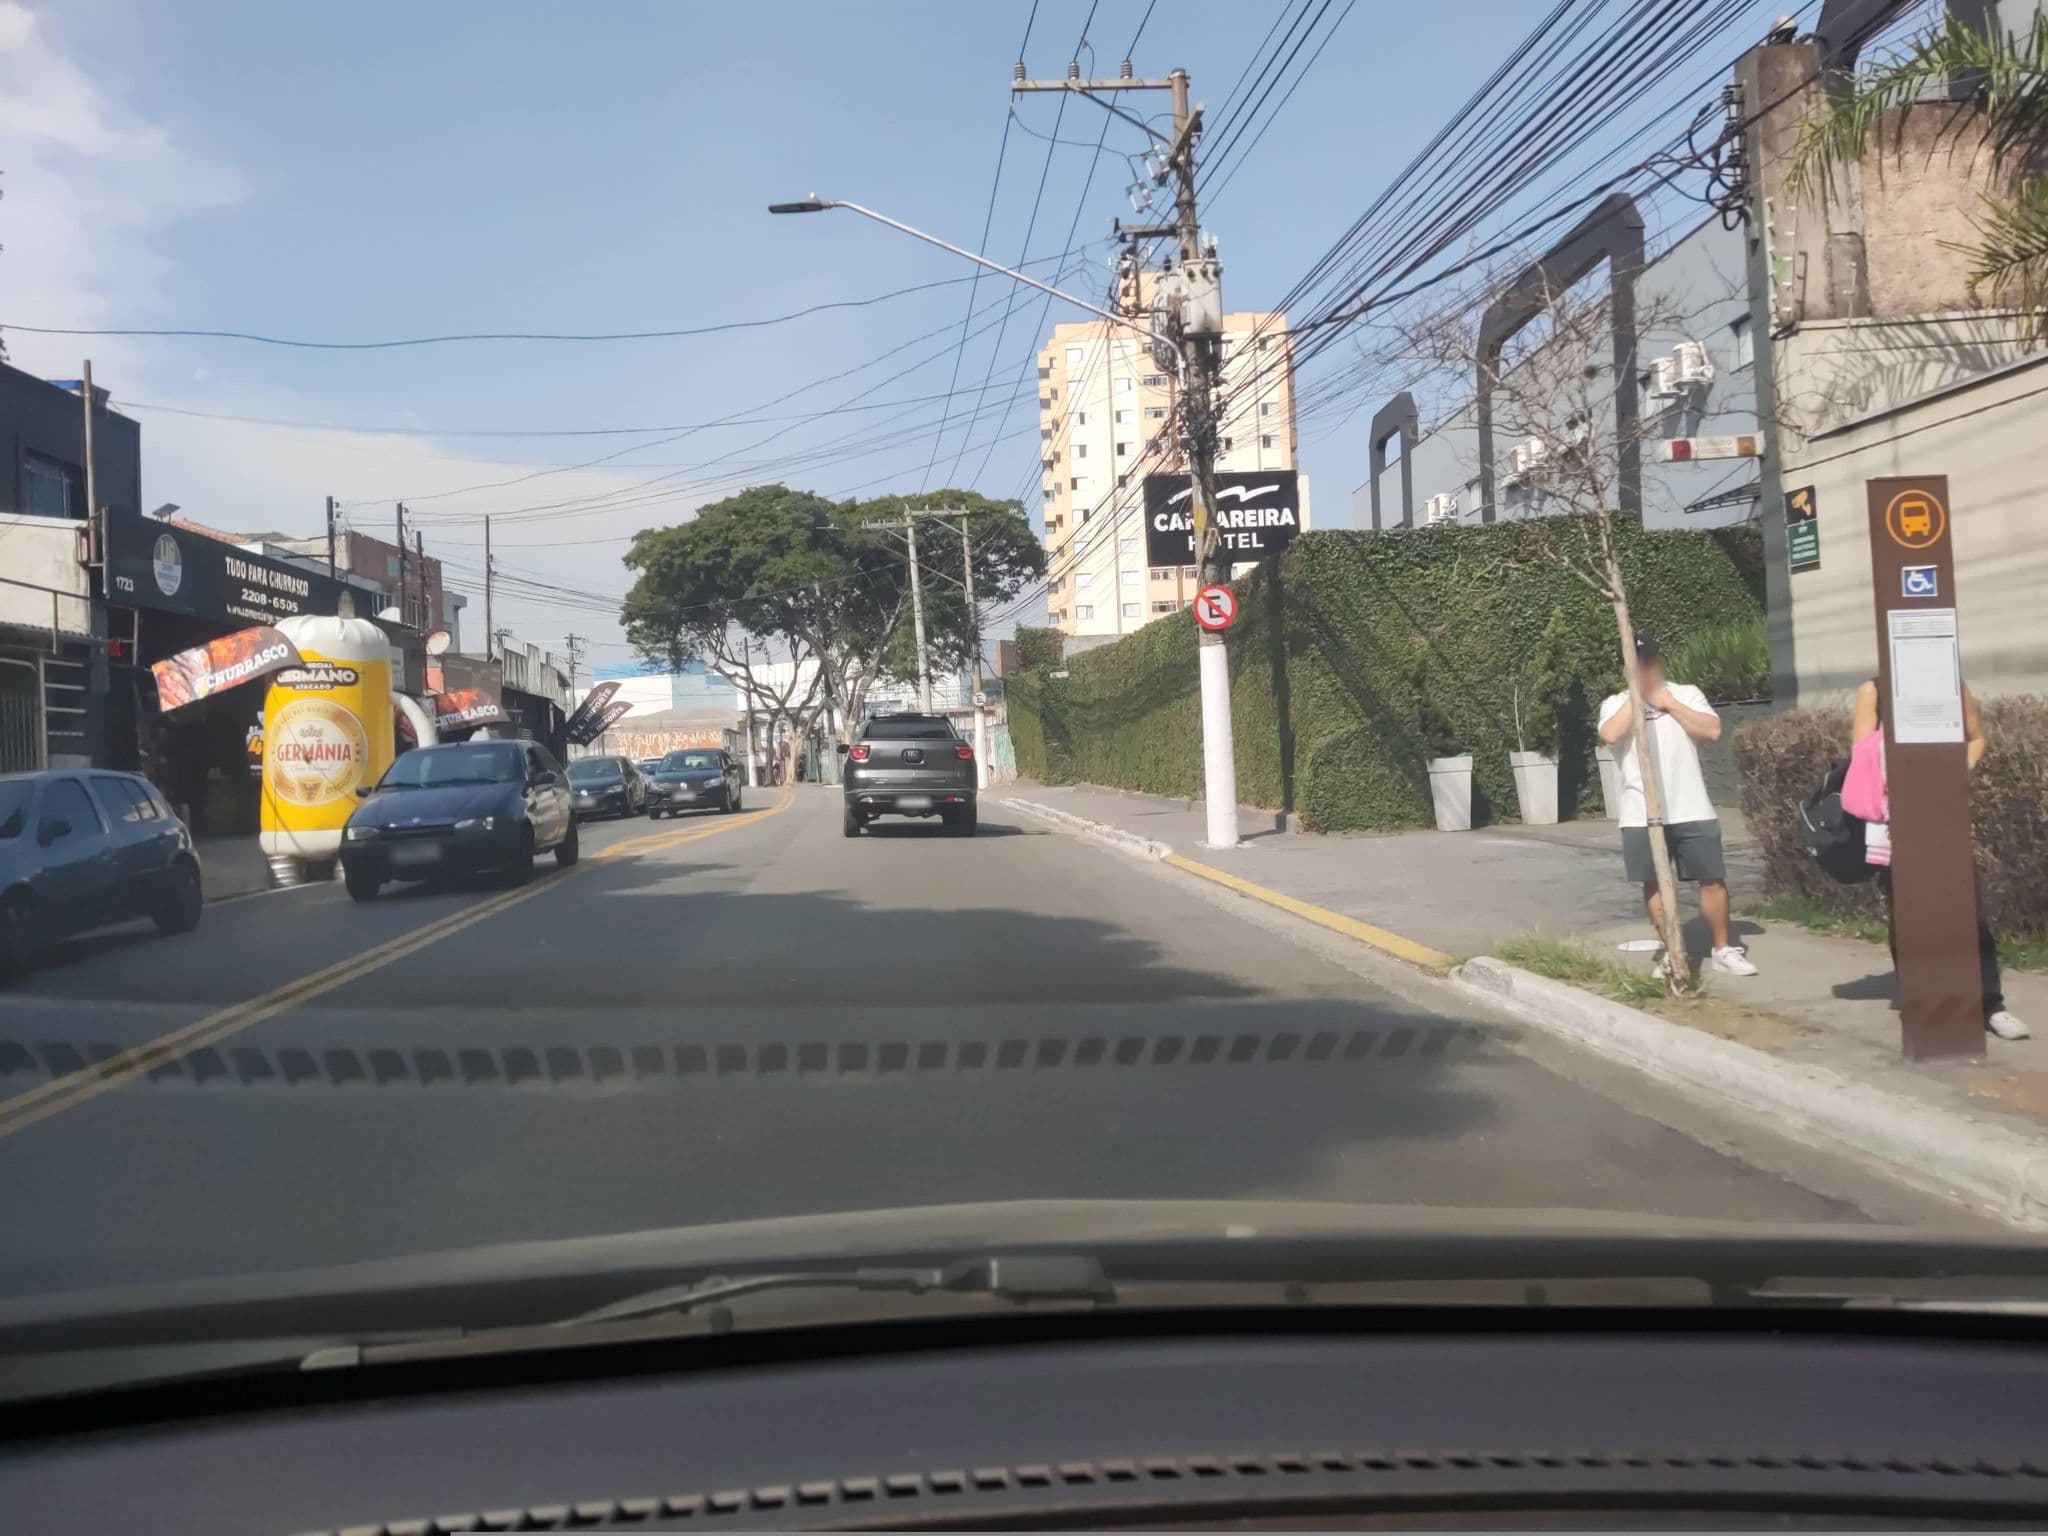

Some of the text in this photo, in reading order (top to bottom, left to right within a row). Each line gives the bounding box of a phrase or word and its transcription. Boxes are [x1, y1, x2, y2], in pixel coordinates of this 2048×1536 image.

[1154, 508, 1296, 532] CANAREIRA
[1188, 532, 1264, 551] HTEL
[116, 576, 134, 592] 1723
[225, 556, 309, 598] TUDO PARA CHURRASCO
[1208, 595, 1221, 619] E
[207, 643, 289, 688] CHURRASCO
[432, 704, 499, 727] CHURRASCO
[584, 687, 613, 722] IMPORTS
[277, 739, 352, 762] GERMÂNIA
